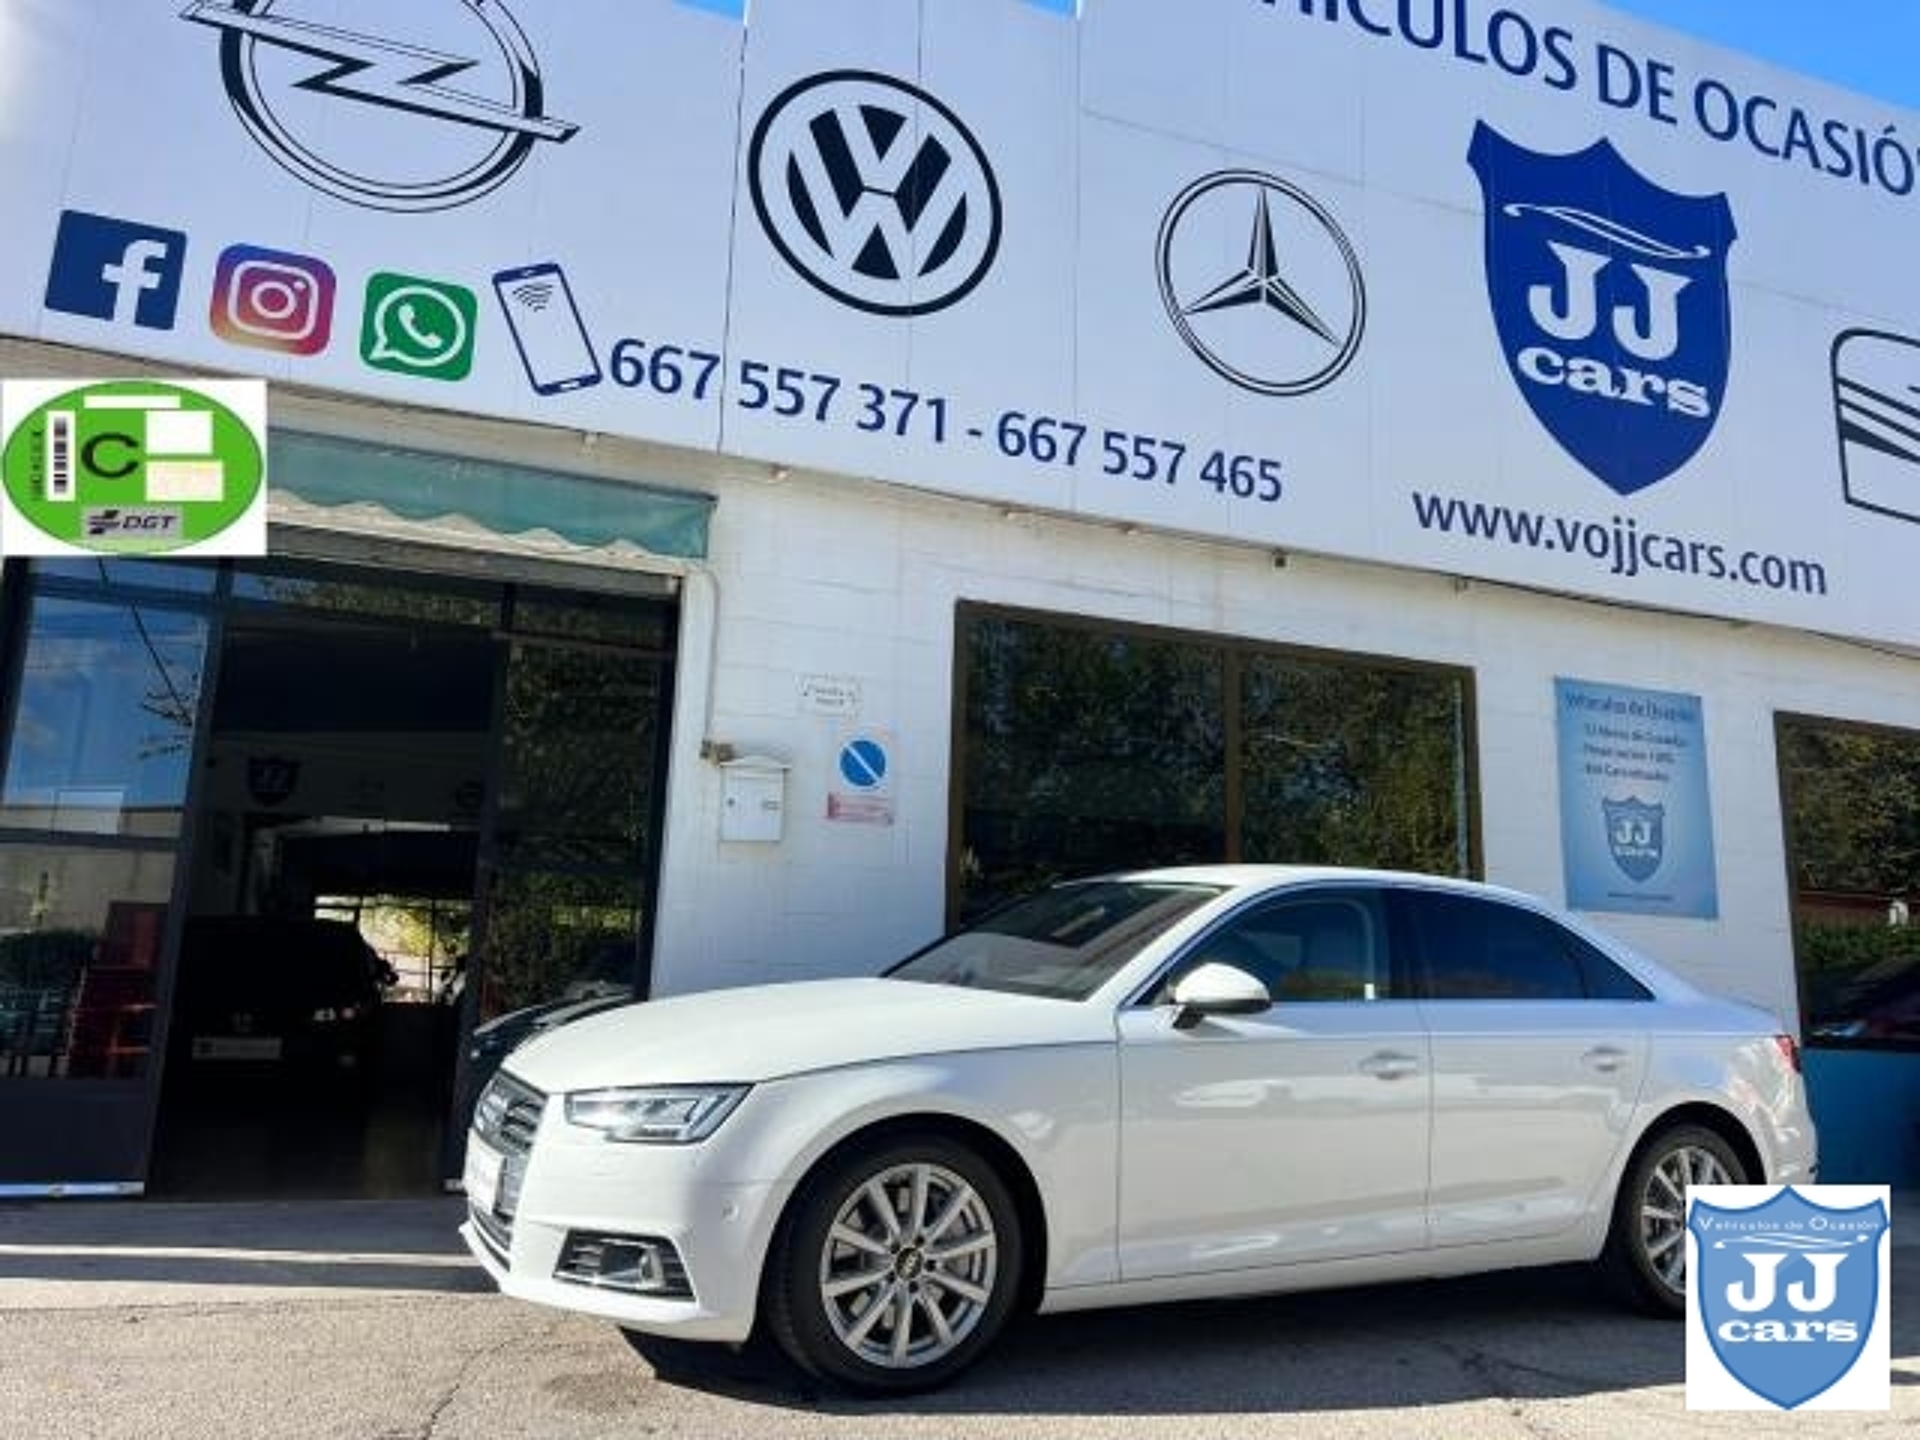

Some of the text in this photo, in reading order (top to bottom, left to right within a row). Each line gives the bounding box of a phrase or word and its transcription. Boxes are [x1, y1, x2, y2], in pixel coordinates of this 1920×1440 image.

[1596, 43, 1678, 126] DE
[1693, 79, 1920, 196] OCASIÓ
[1527, 239, 1693, 362] JJ
[610, 337, 721, 400] 667
[737, 360, 841, 422] 557
[855, 383, 947, 443] 371
[997, 411, 1087, 466] 667
[1102, 430, 1187, 485] 557
[1199, 450, 1283, 502] 465
[1517, 345, 1711, 419] cars
[1411, 490, 1828, 596] www.vojjcars.com
